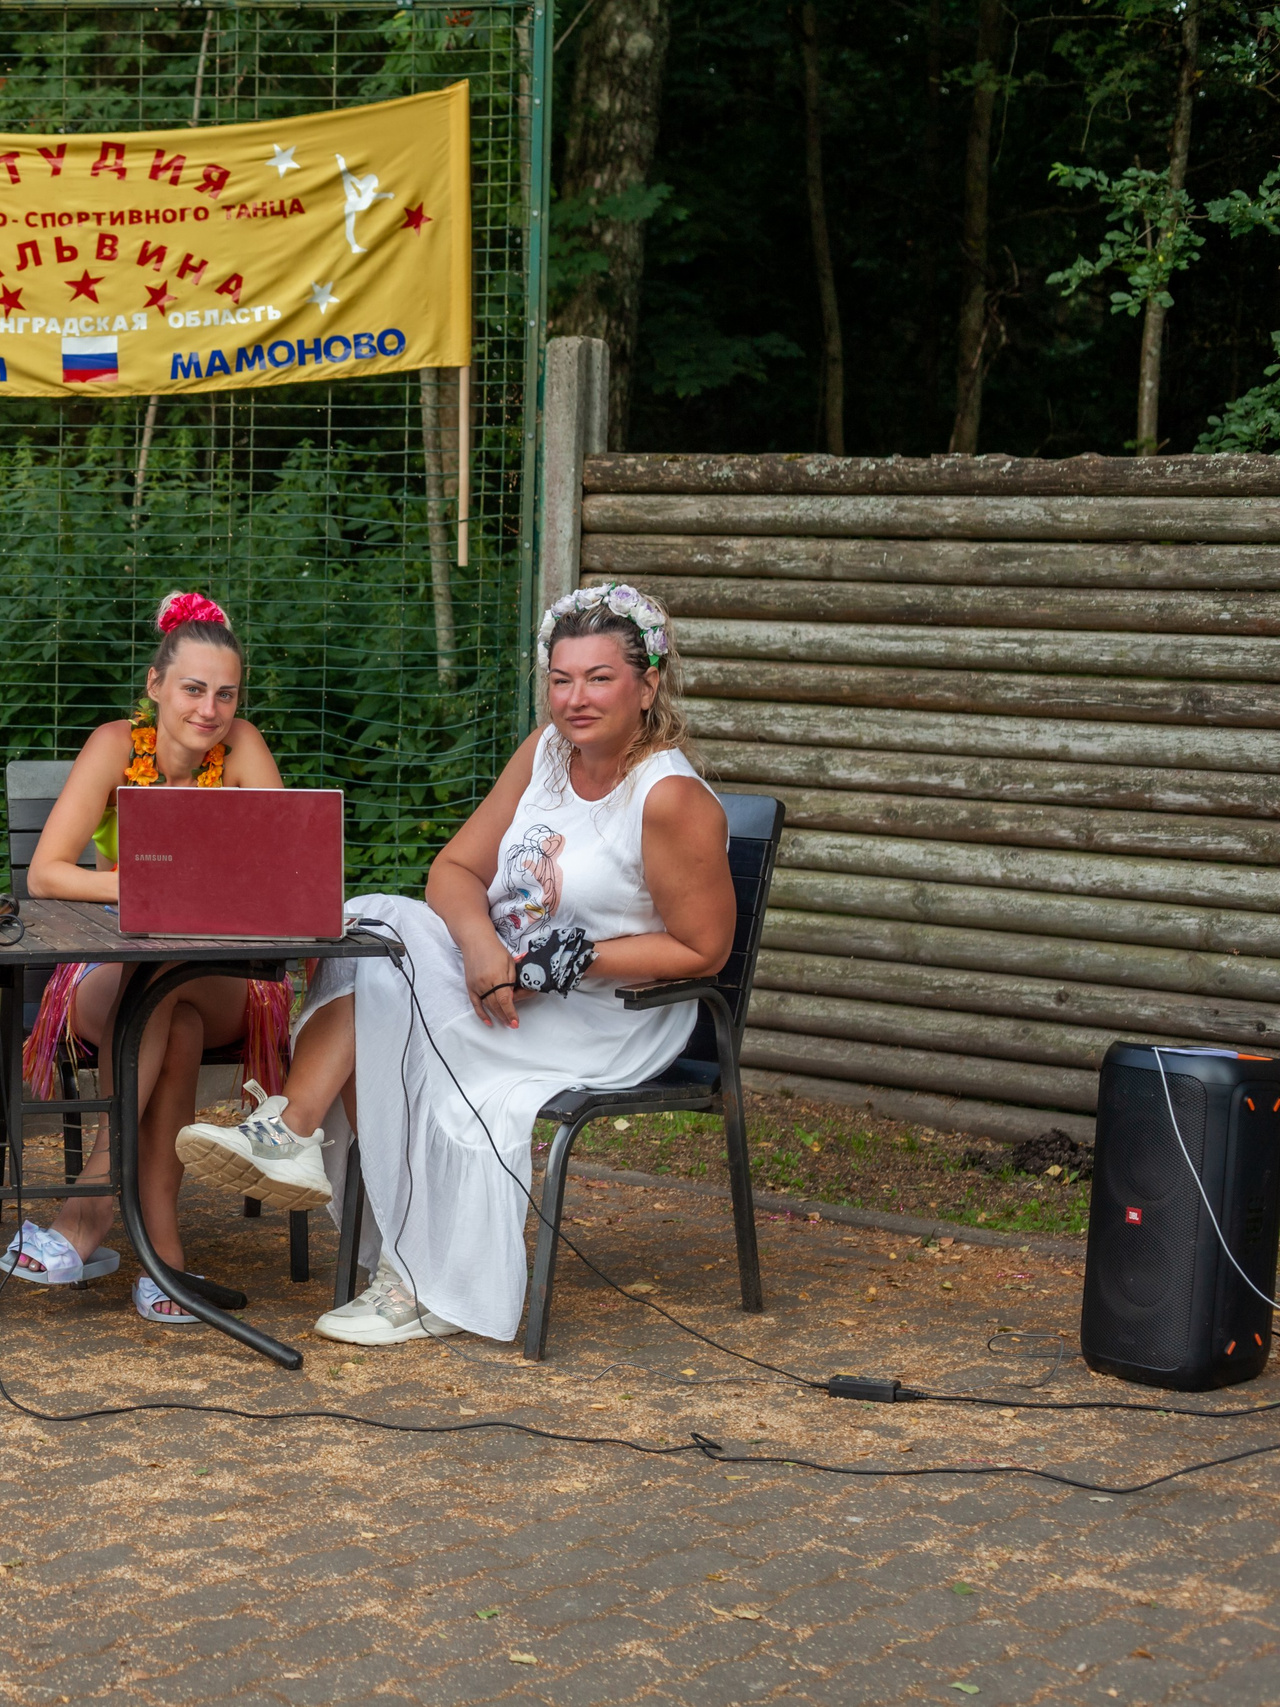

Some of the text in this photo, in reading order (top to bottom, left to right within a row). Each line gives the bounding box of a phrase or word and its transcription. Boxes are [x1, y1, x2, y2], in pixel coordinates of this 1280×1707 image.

[222, 197, 305, 221] ТАНЦА
[168, 304, 282, 330] ОБЛАСТЬ
[170, 328, 406, 380] МАМОНОВО
[134, 853, 173, 862] SAMSUNG
